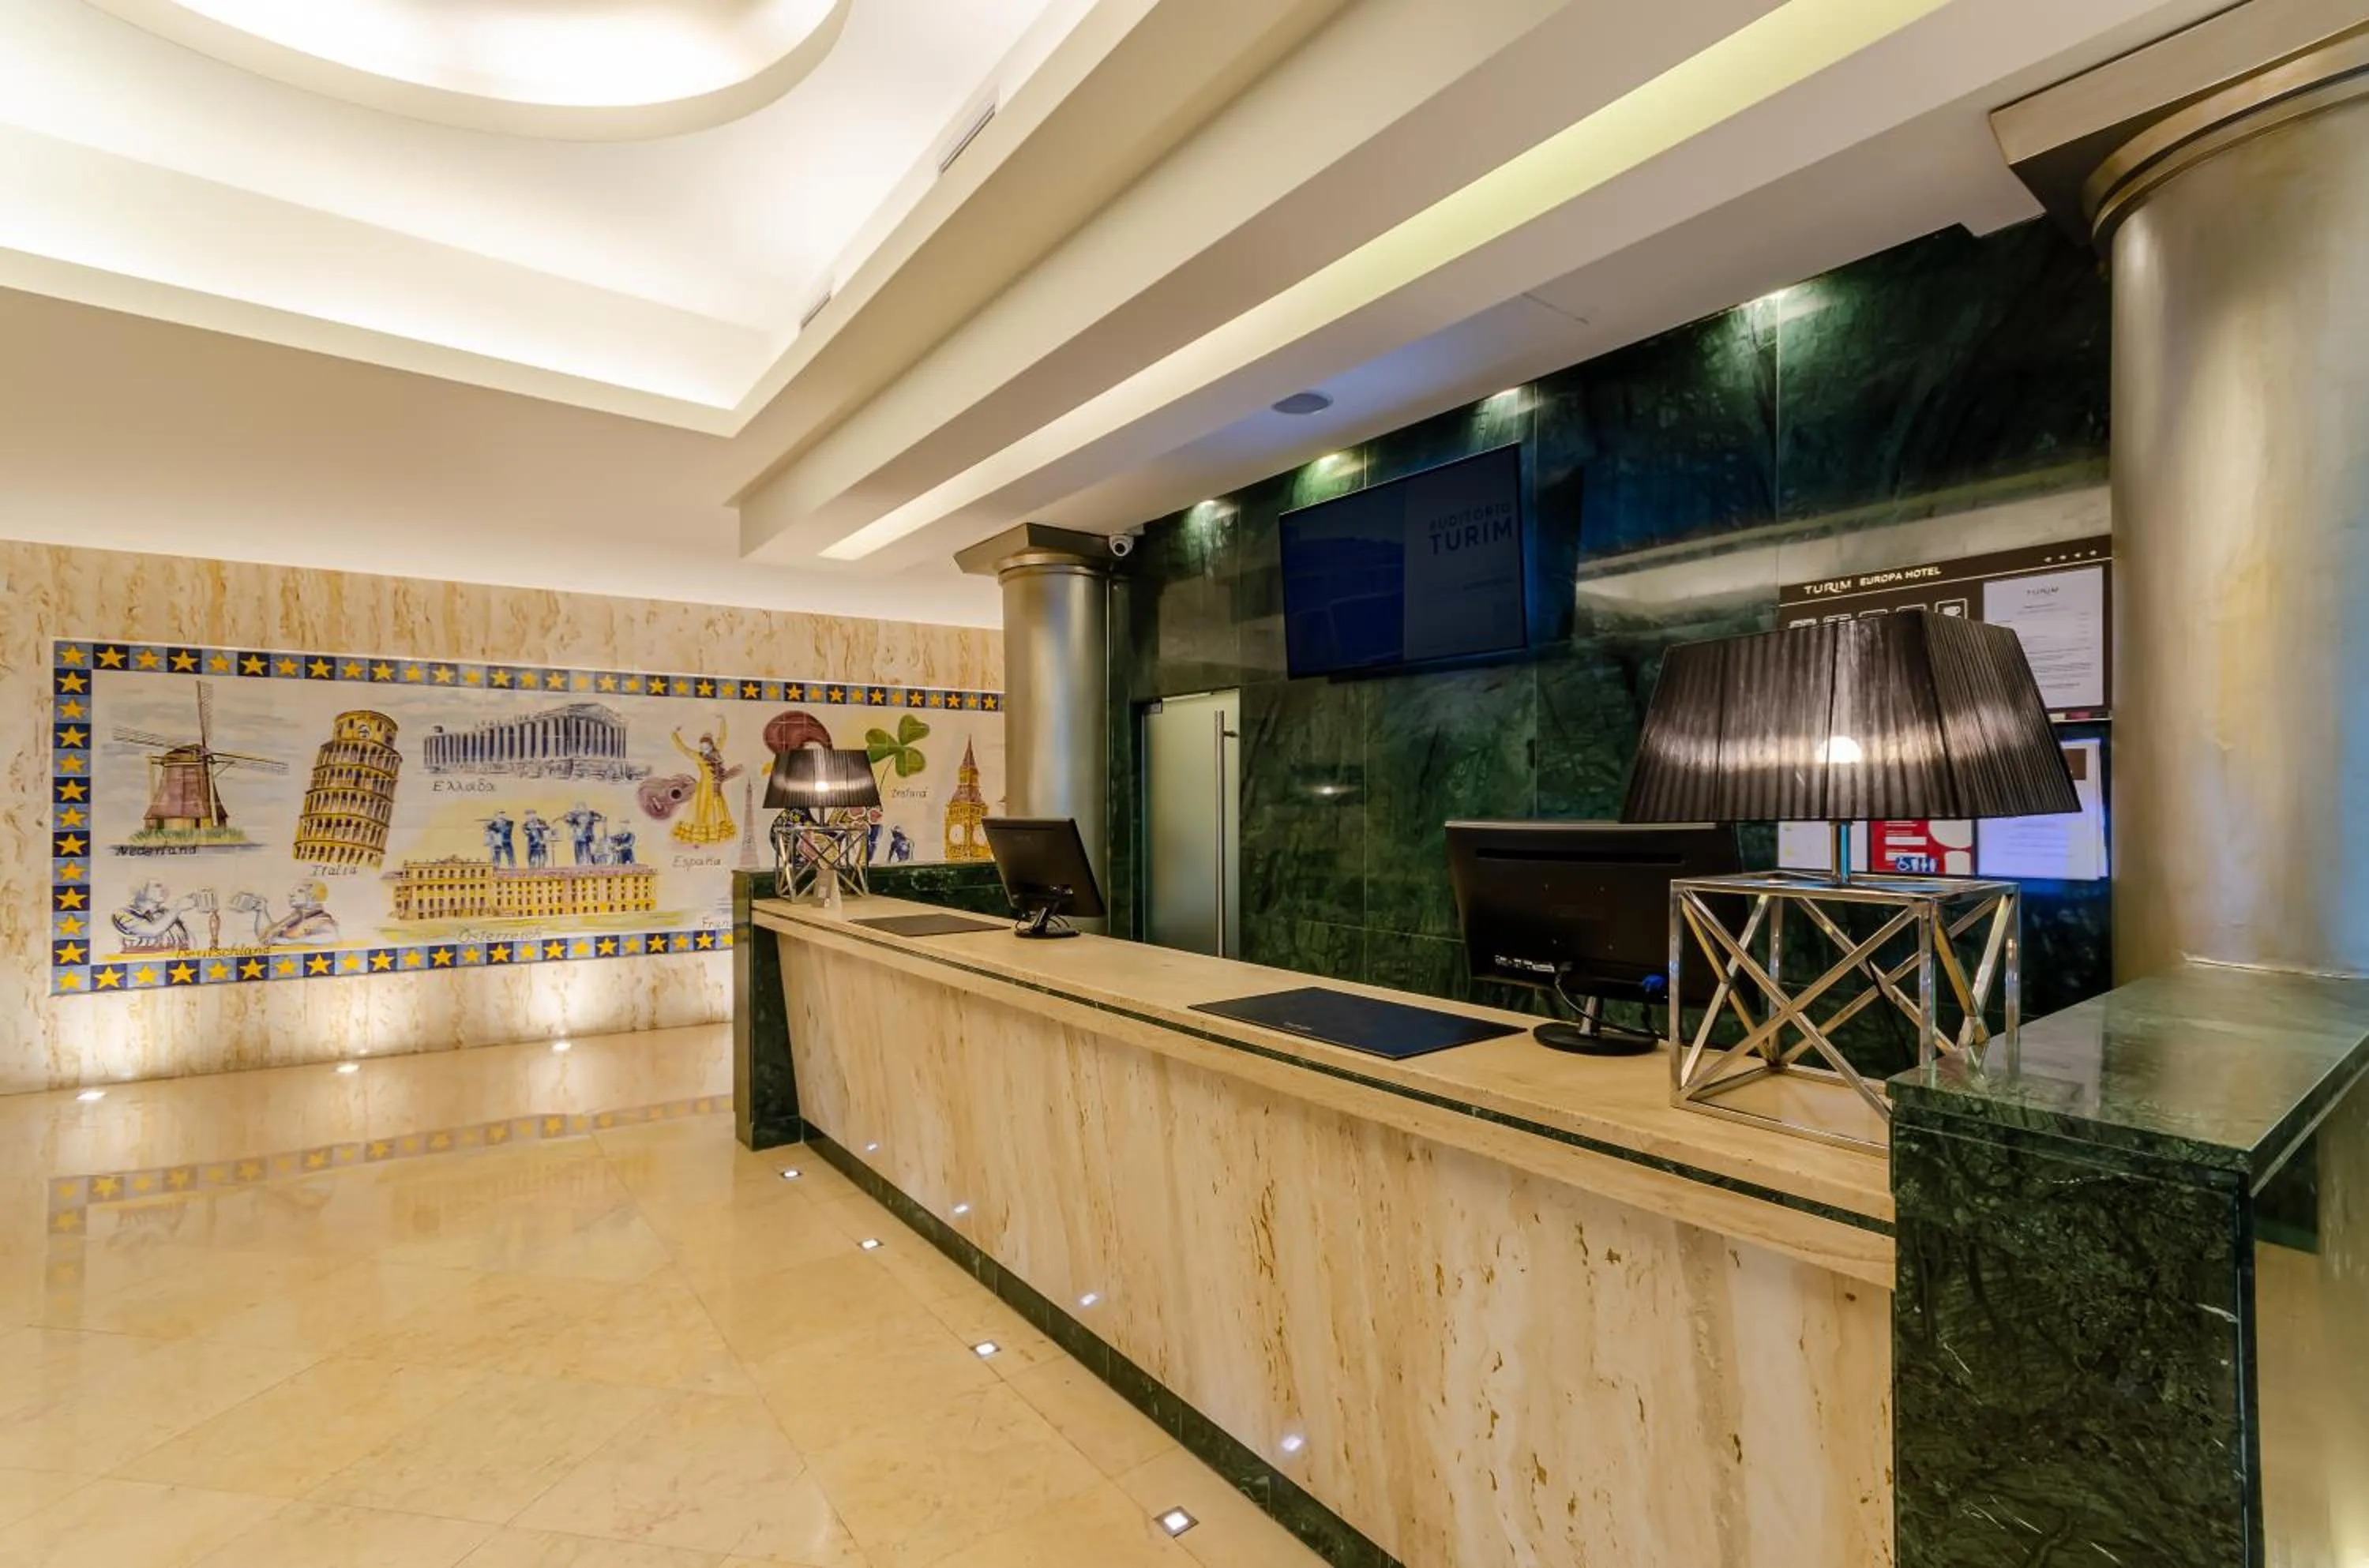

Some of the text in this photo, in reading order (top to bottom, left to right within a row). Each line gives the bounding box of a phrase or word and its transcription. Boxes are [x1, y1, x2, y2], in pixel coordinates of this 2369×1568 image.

[1429, 516, 1512, 555] TURIM
[1804, 566, 1942, 594] TURIM EUROPA HOTEL
[310, 865, 358, 876] Italia
